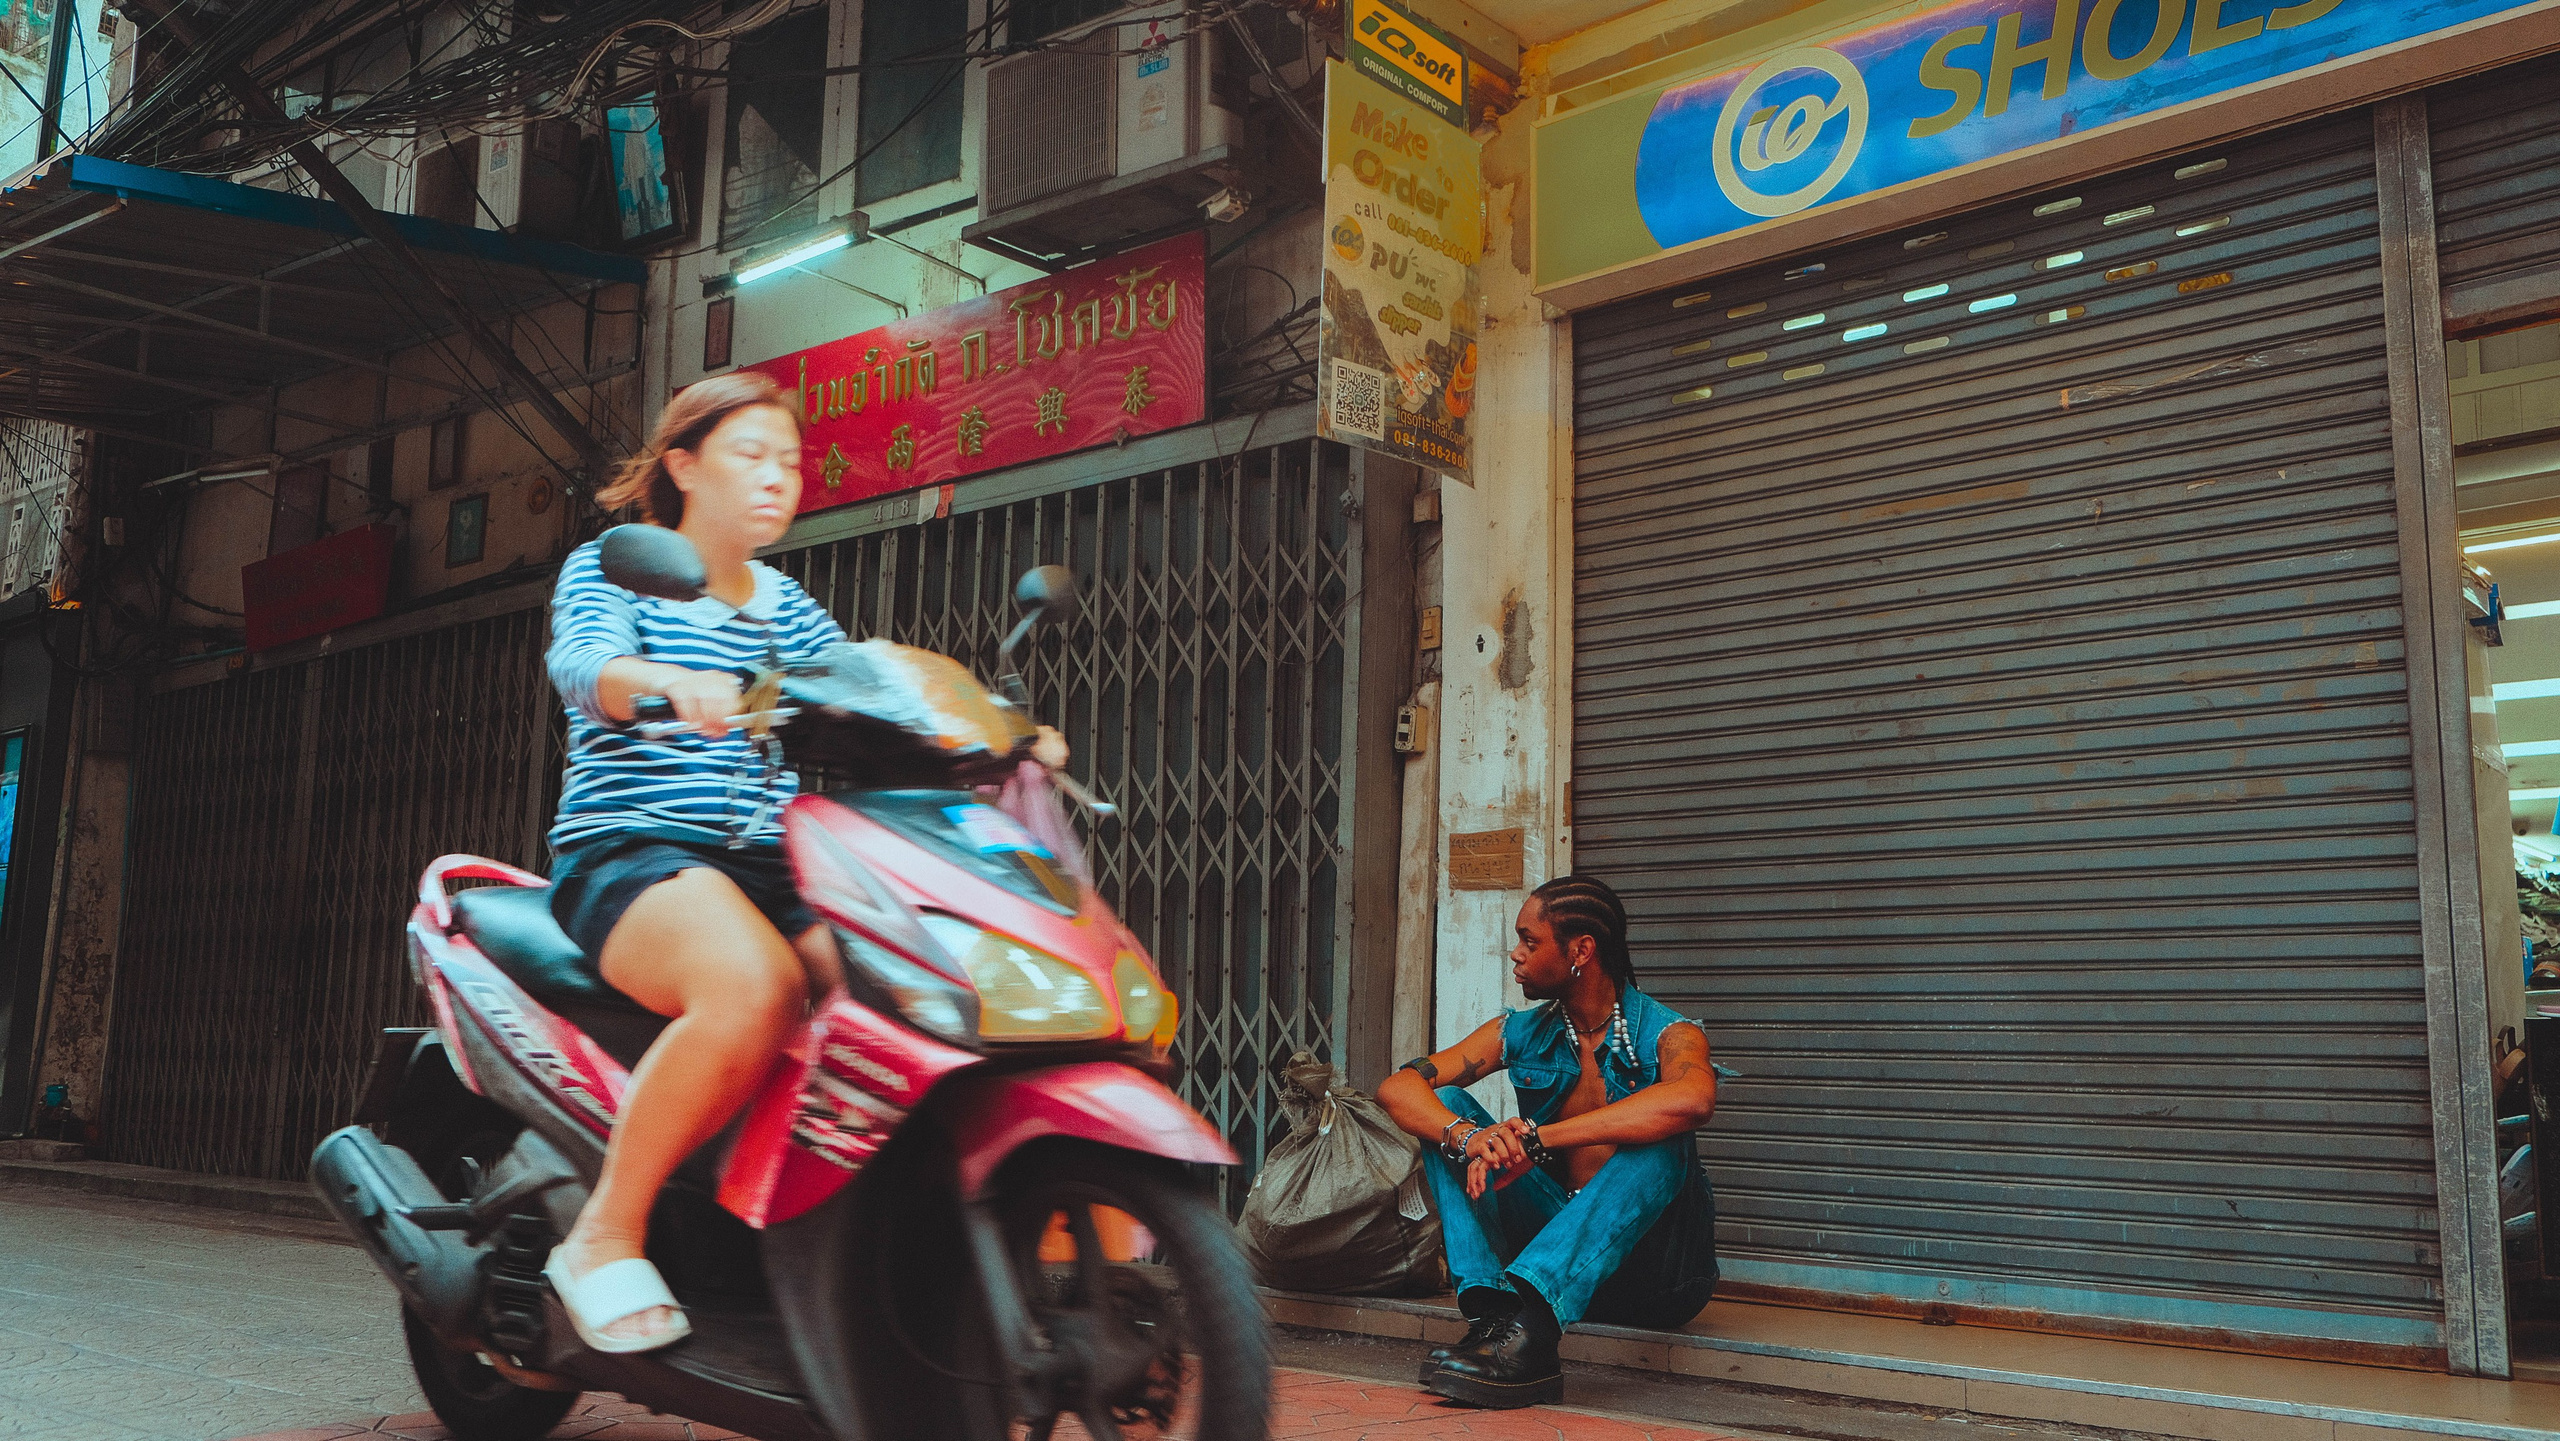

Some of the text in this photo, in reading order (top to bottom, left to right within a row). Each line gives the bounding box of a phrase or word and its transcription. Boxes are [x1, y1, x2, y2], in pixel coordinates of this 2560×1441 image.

[1363, 57, 1448, 116] ORIGINAL COMFORT
[1351, 101, 1454, 193] Make to
[1353, 149, 1449, 220] Order
[1355, 202, 1382, 220] call
[1370, 241, 1408, 279] PU
[1378, 304, 1422, 336] slipper
[1402, 291, 1443, 321] sandals
[873, 499, 910, 523] 418
